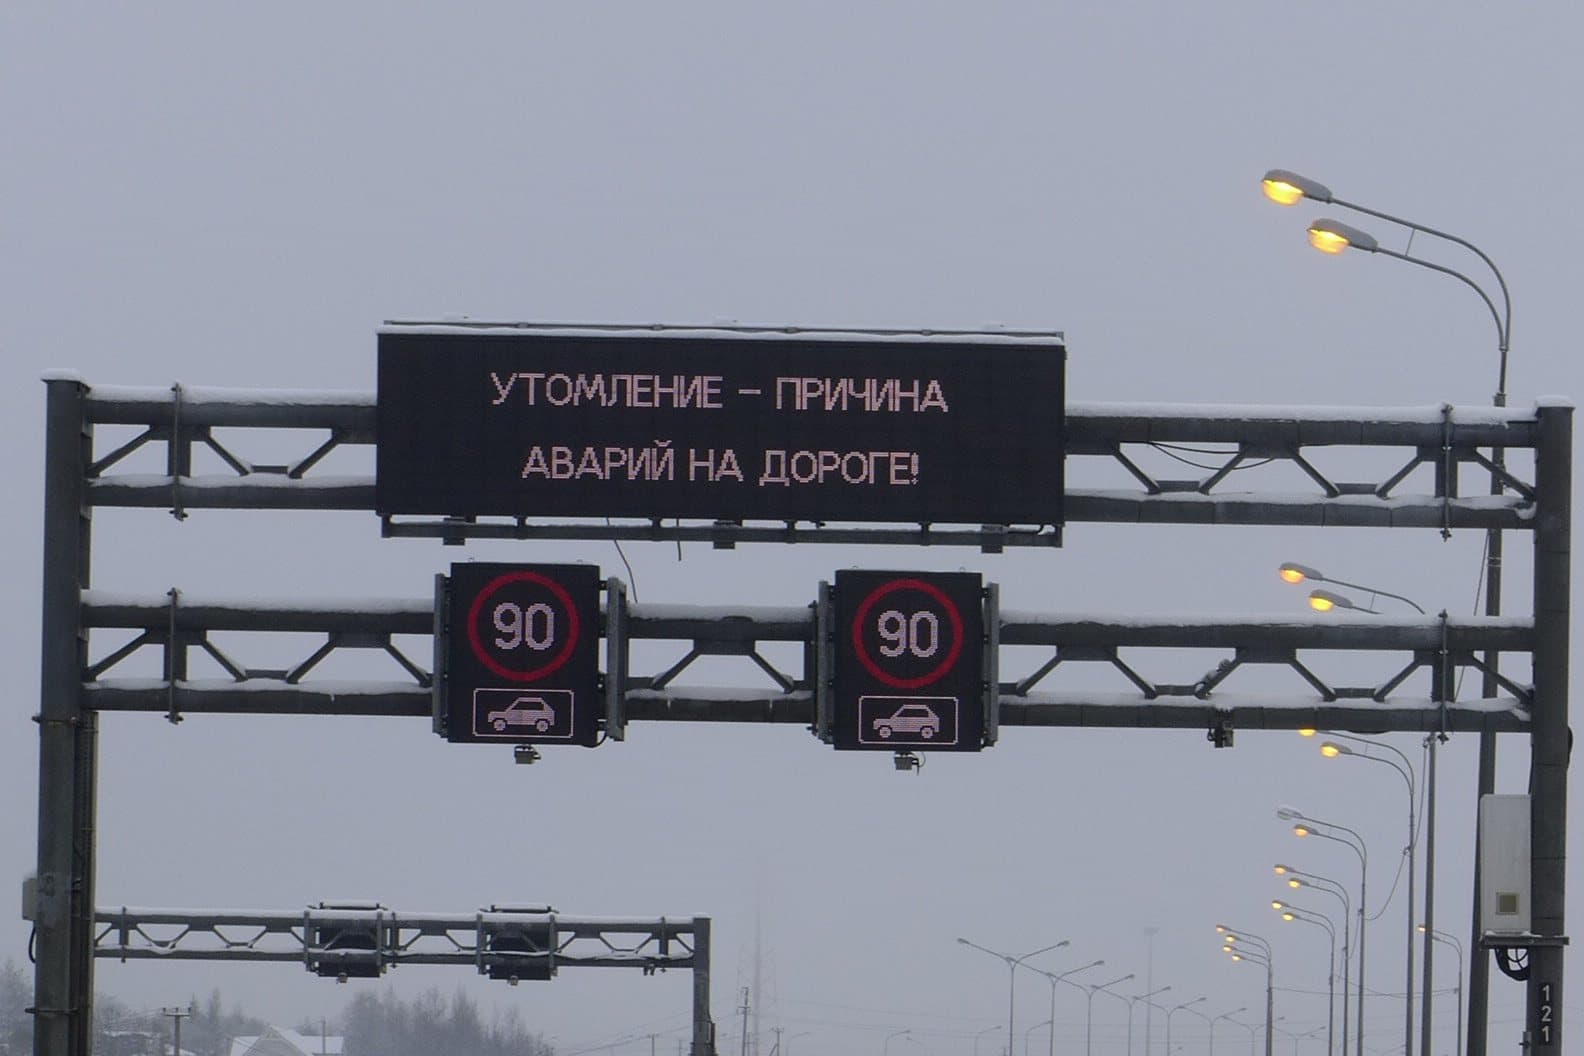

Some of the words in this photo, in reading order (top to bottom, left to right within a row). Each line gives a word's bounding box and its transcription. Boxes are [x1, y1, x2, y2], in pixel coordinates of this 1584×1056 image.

[490, 372, 723, 409] УТОМЛЕНИЕ
[776, 376, 949, 413] ПРИЧИНА
[521, 440, 675, 481] АВАРИЙ
[689, 448, 744, 482] НА
[759, 450, 920, 487] ДОРОГЕ!
[492, 602, 555, 651] 90
[877, 610, 939, 658] 90
